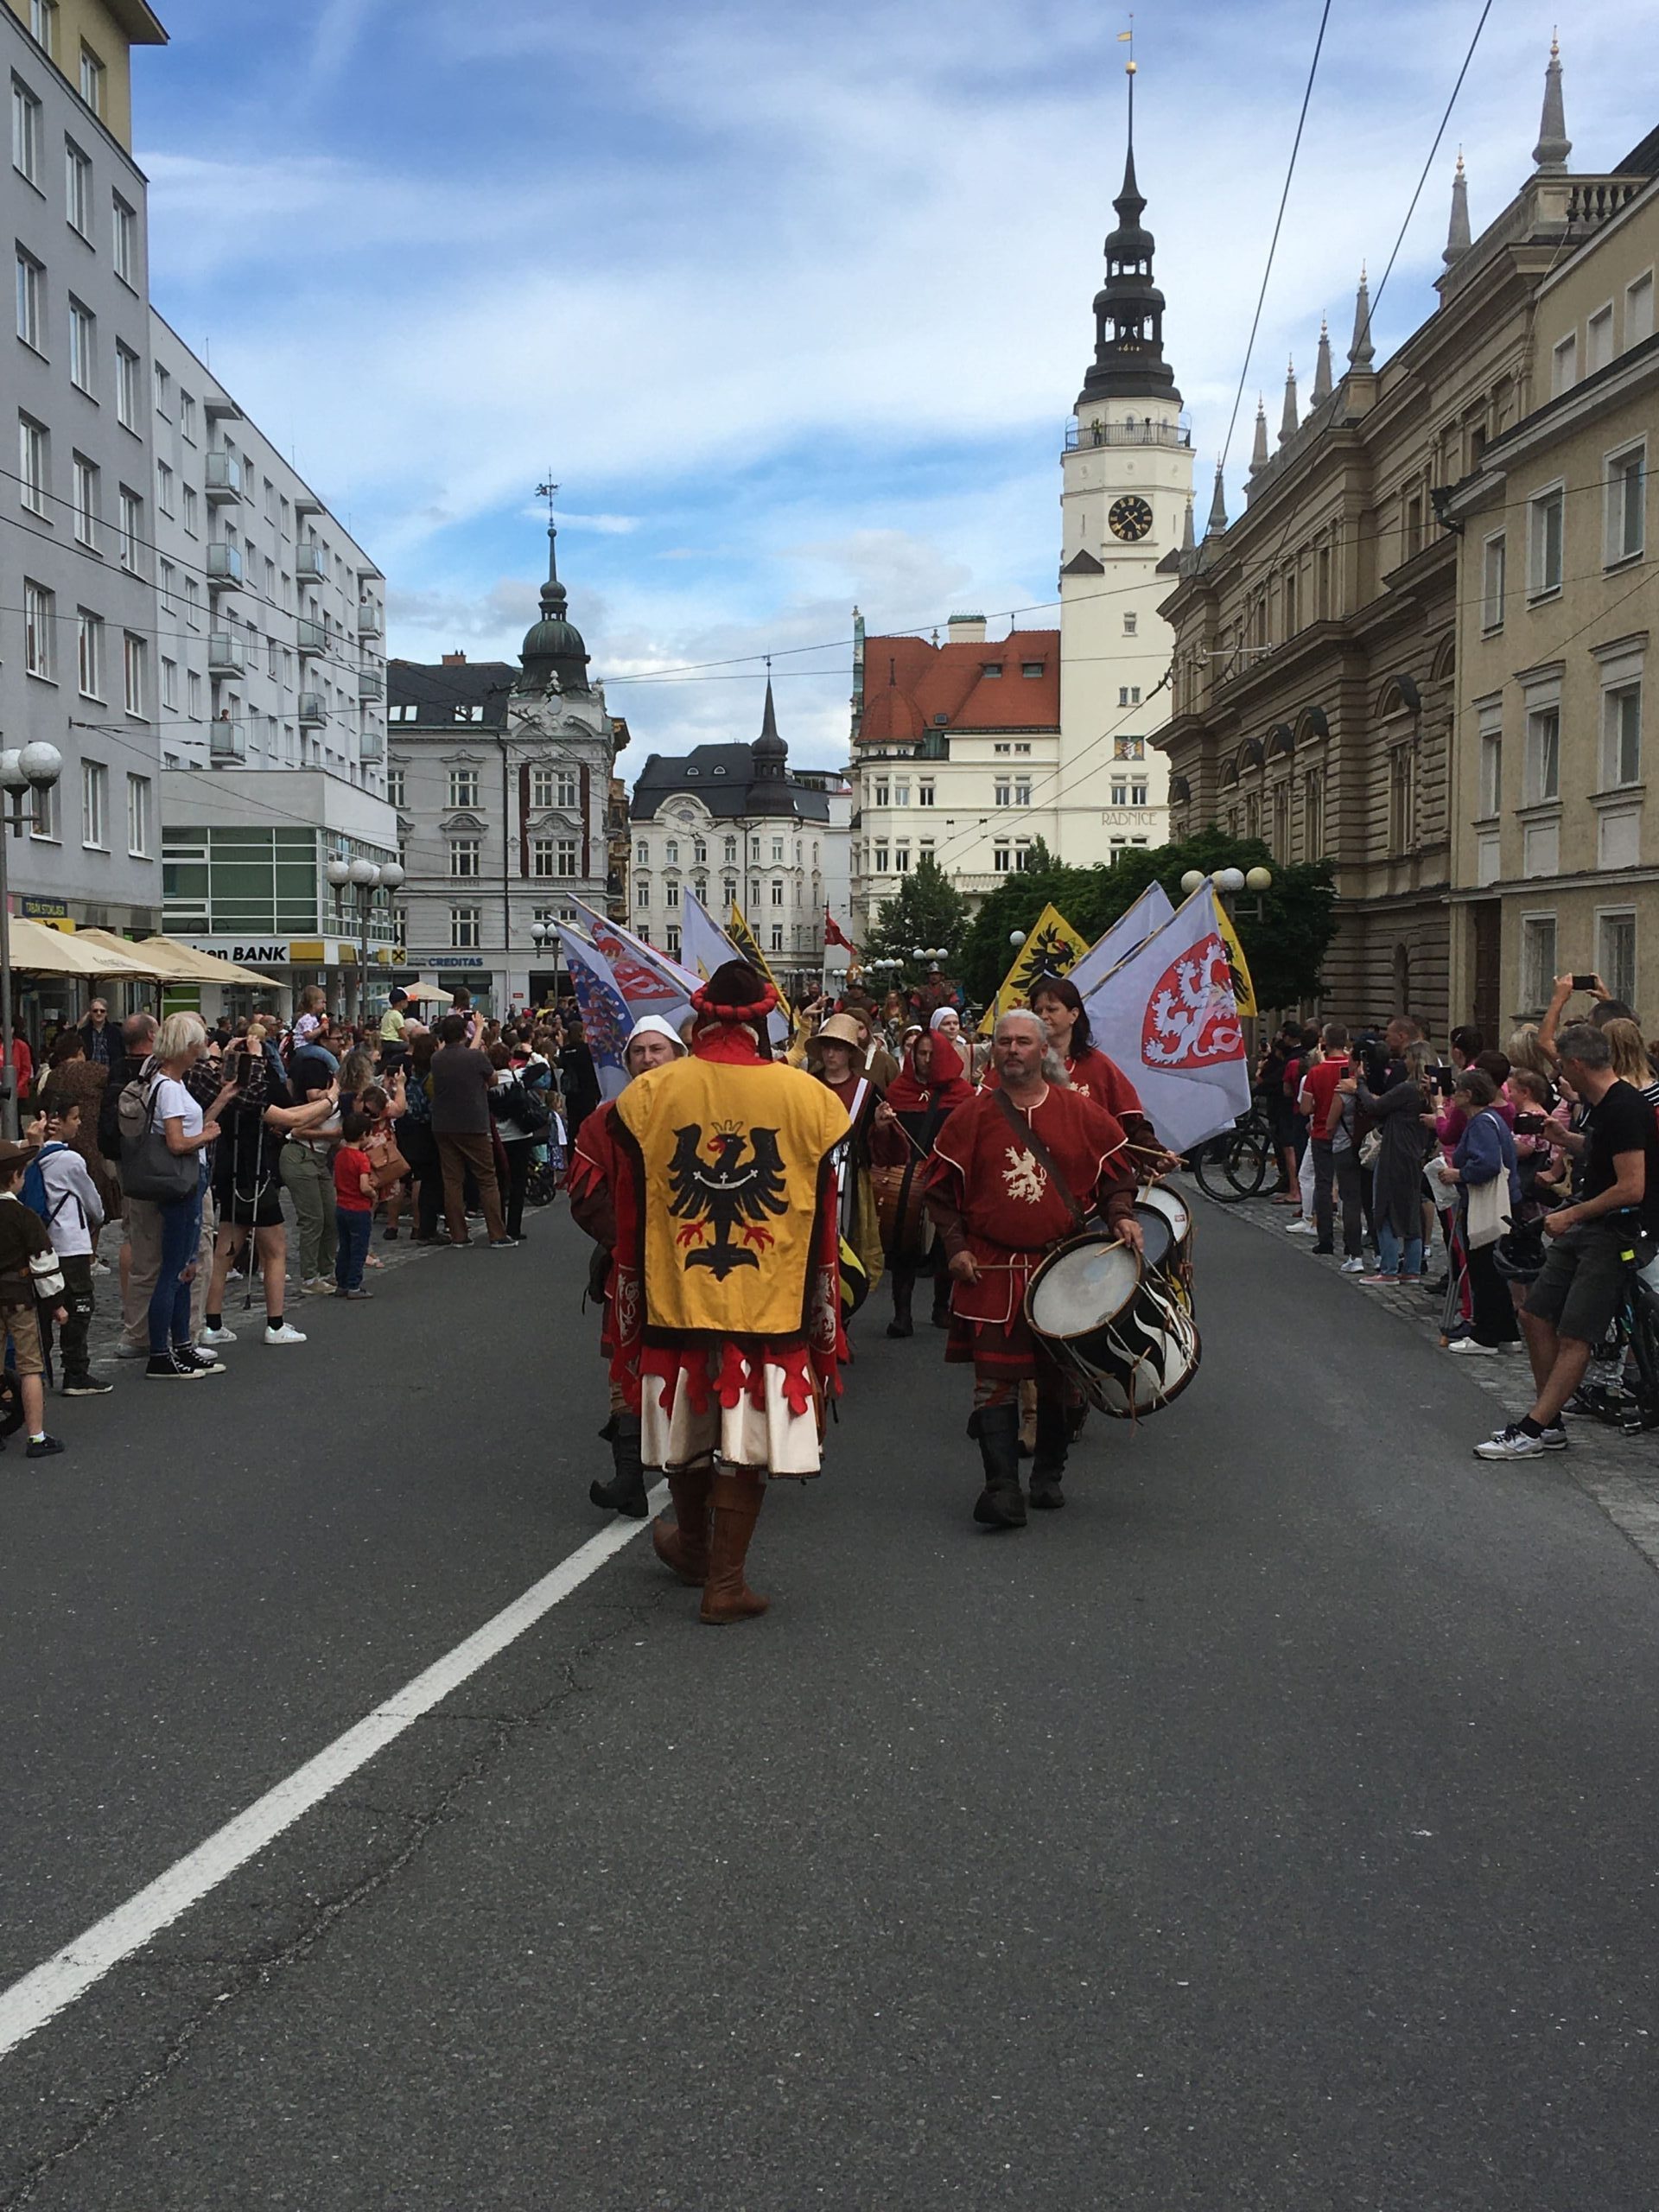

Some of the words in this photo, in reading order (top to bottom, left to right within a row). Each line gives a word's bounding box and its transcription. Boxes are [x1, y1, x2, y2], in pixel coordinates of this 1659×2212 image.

[1102, 811, 1157, 825] RADNICE
[232, 946, 287, 962] BANK
[429, 957, 484, 967] CREDITAS
